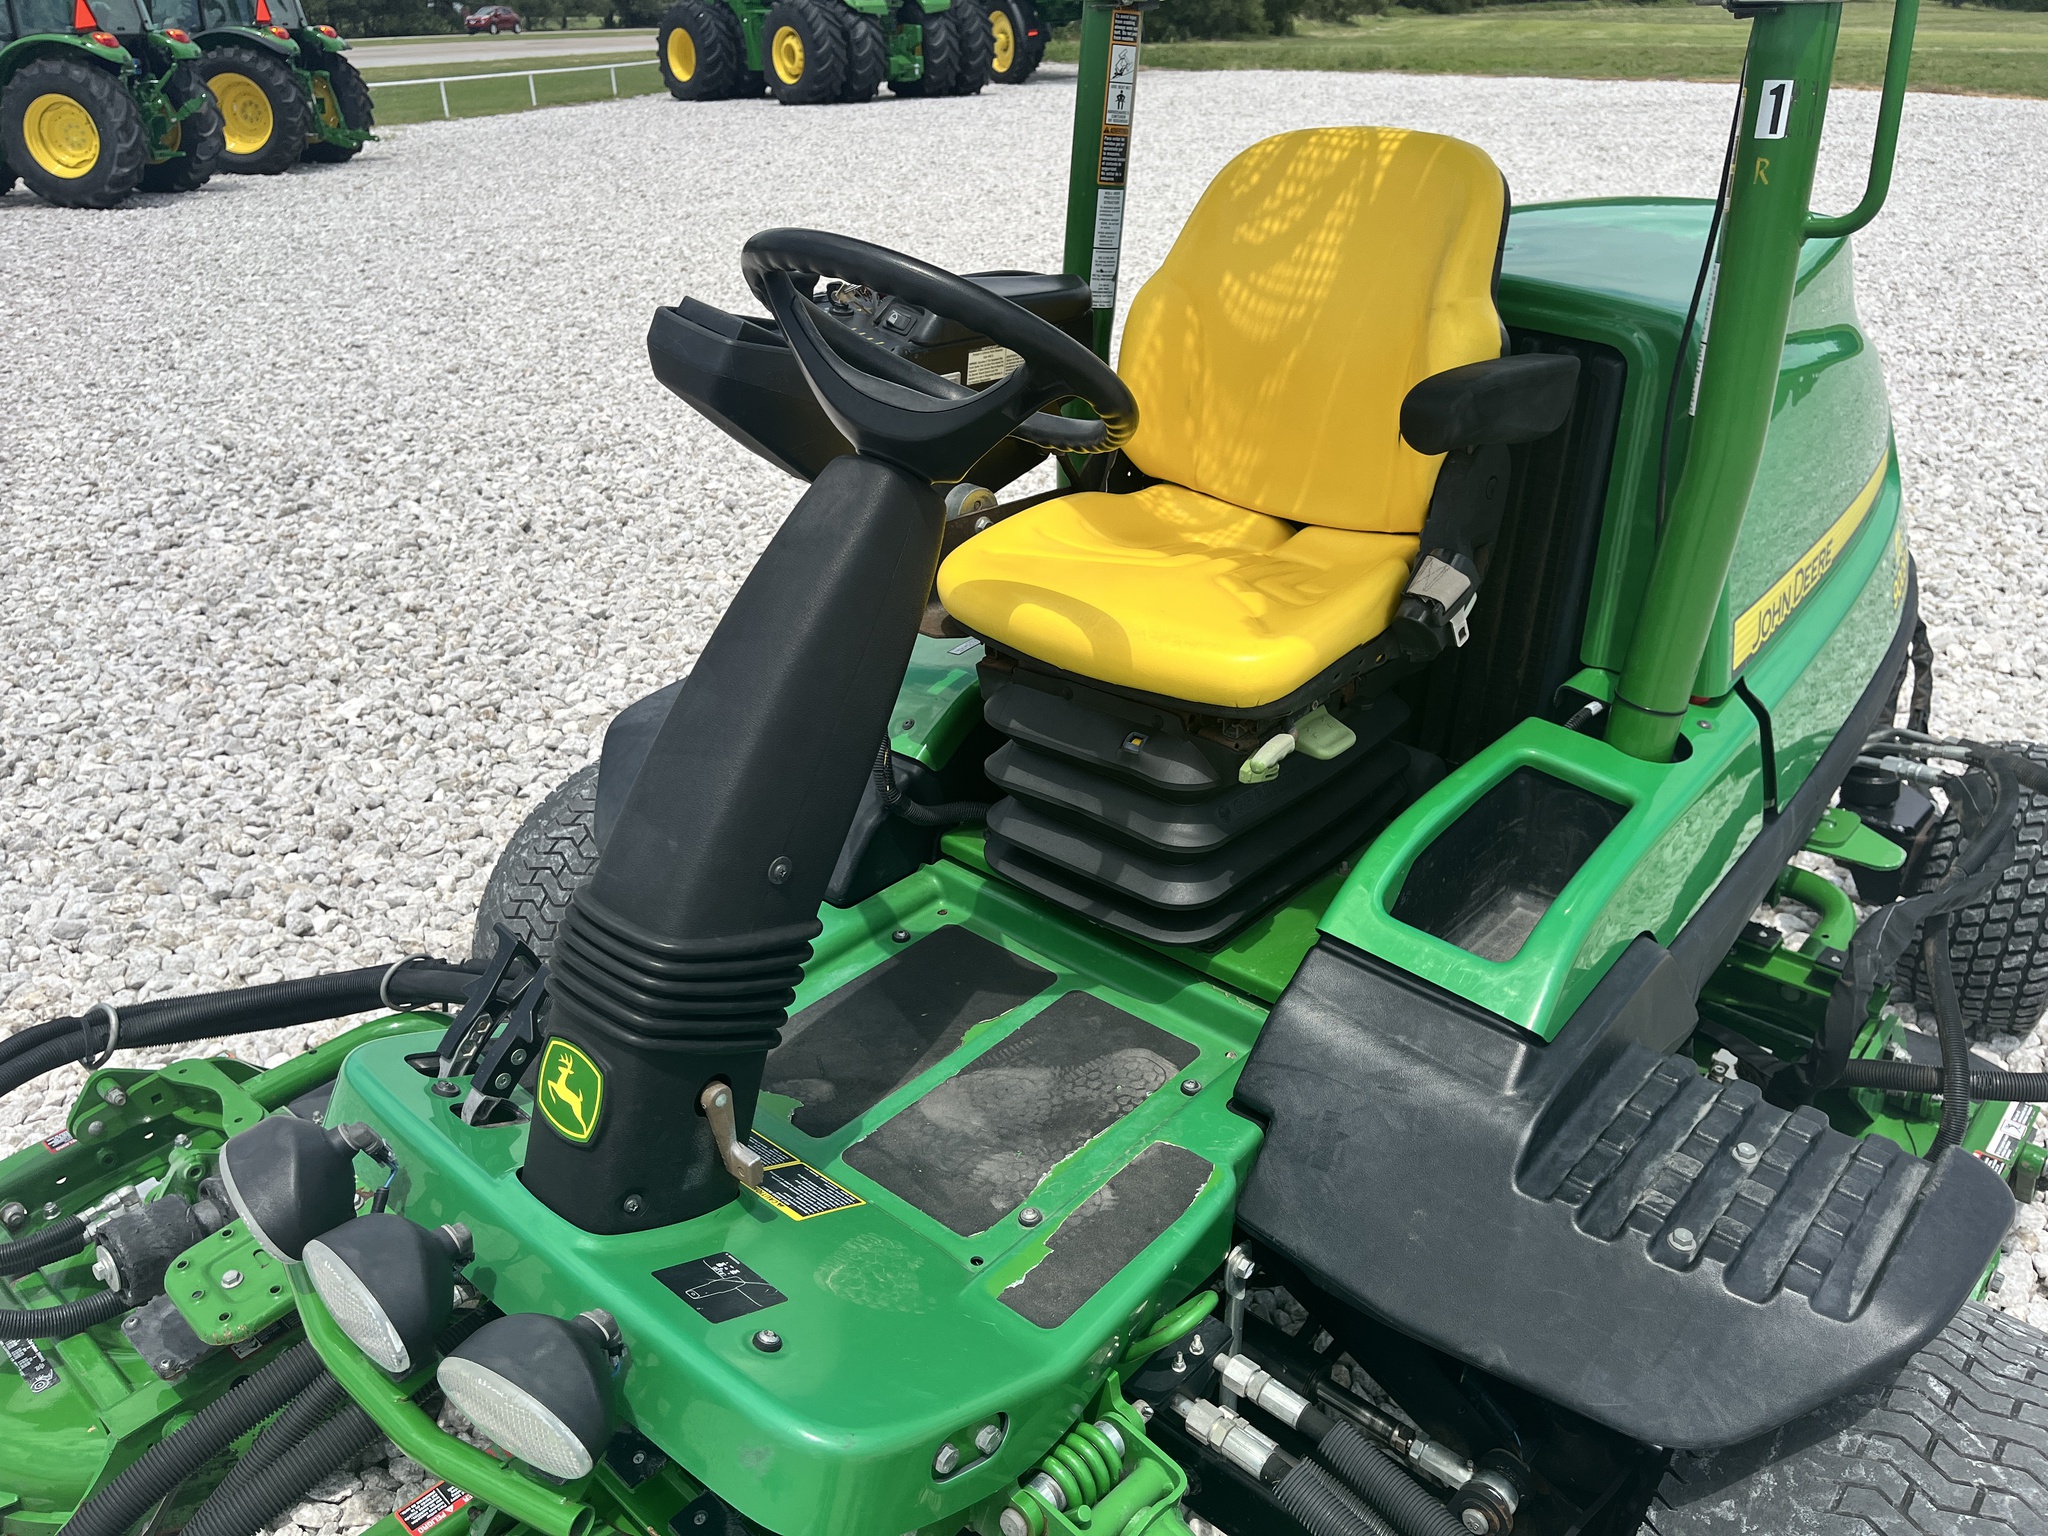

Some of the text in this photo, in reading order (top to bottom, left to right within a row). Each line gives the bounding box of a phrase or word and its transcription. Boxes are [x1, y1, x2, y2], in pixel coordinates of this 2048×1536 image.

[1769, 83, 1786, 135] 1
[1753, 157, 1770, 186] R
[1752, 538, 1834, 650] JOHN DEERE
[754, 1186, 779, 1205] CAUTION
[417, 1511, 448, 1534] PELIGRO
